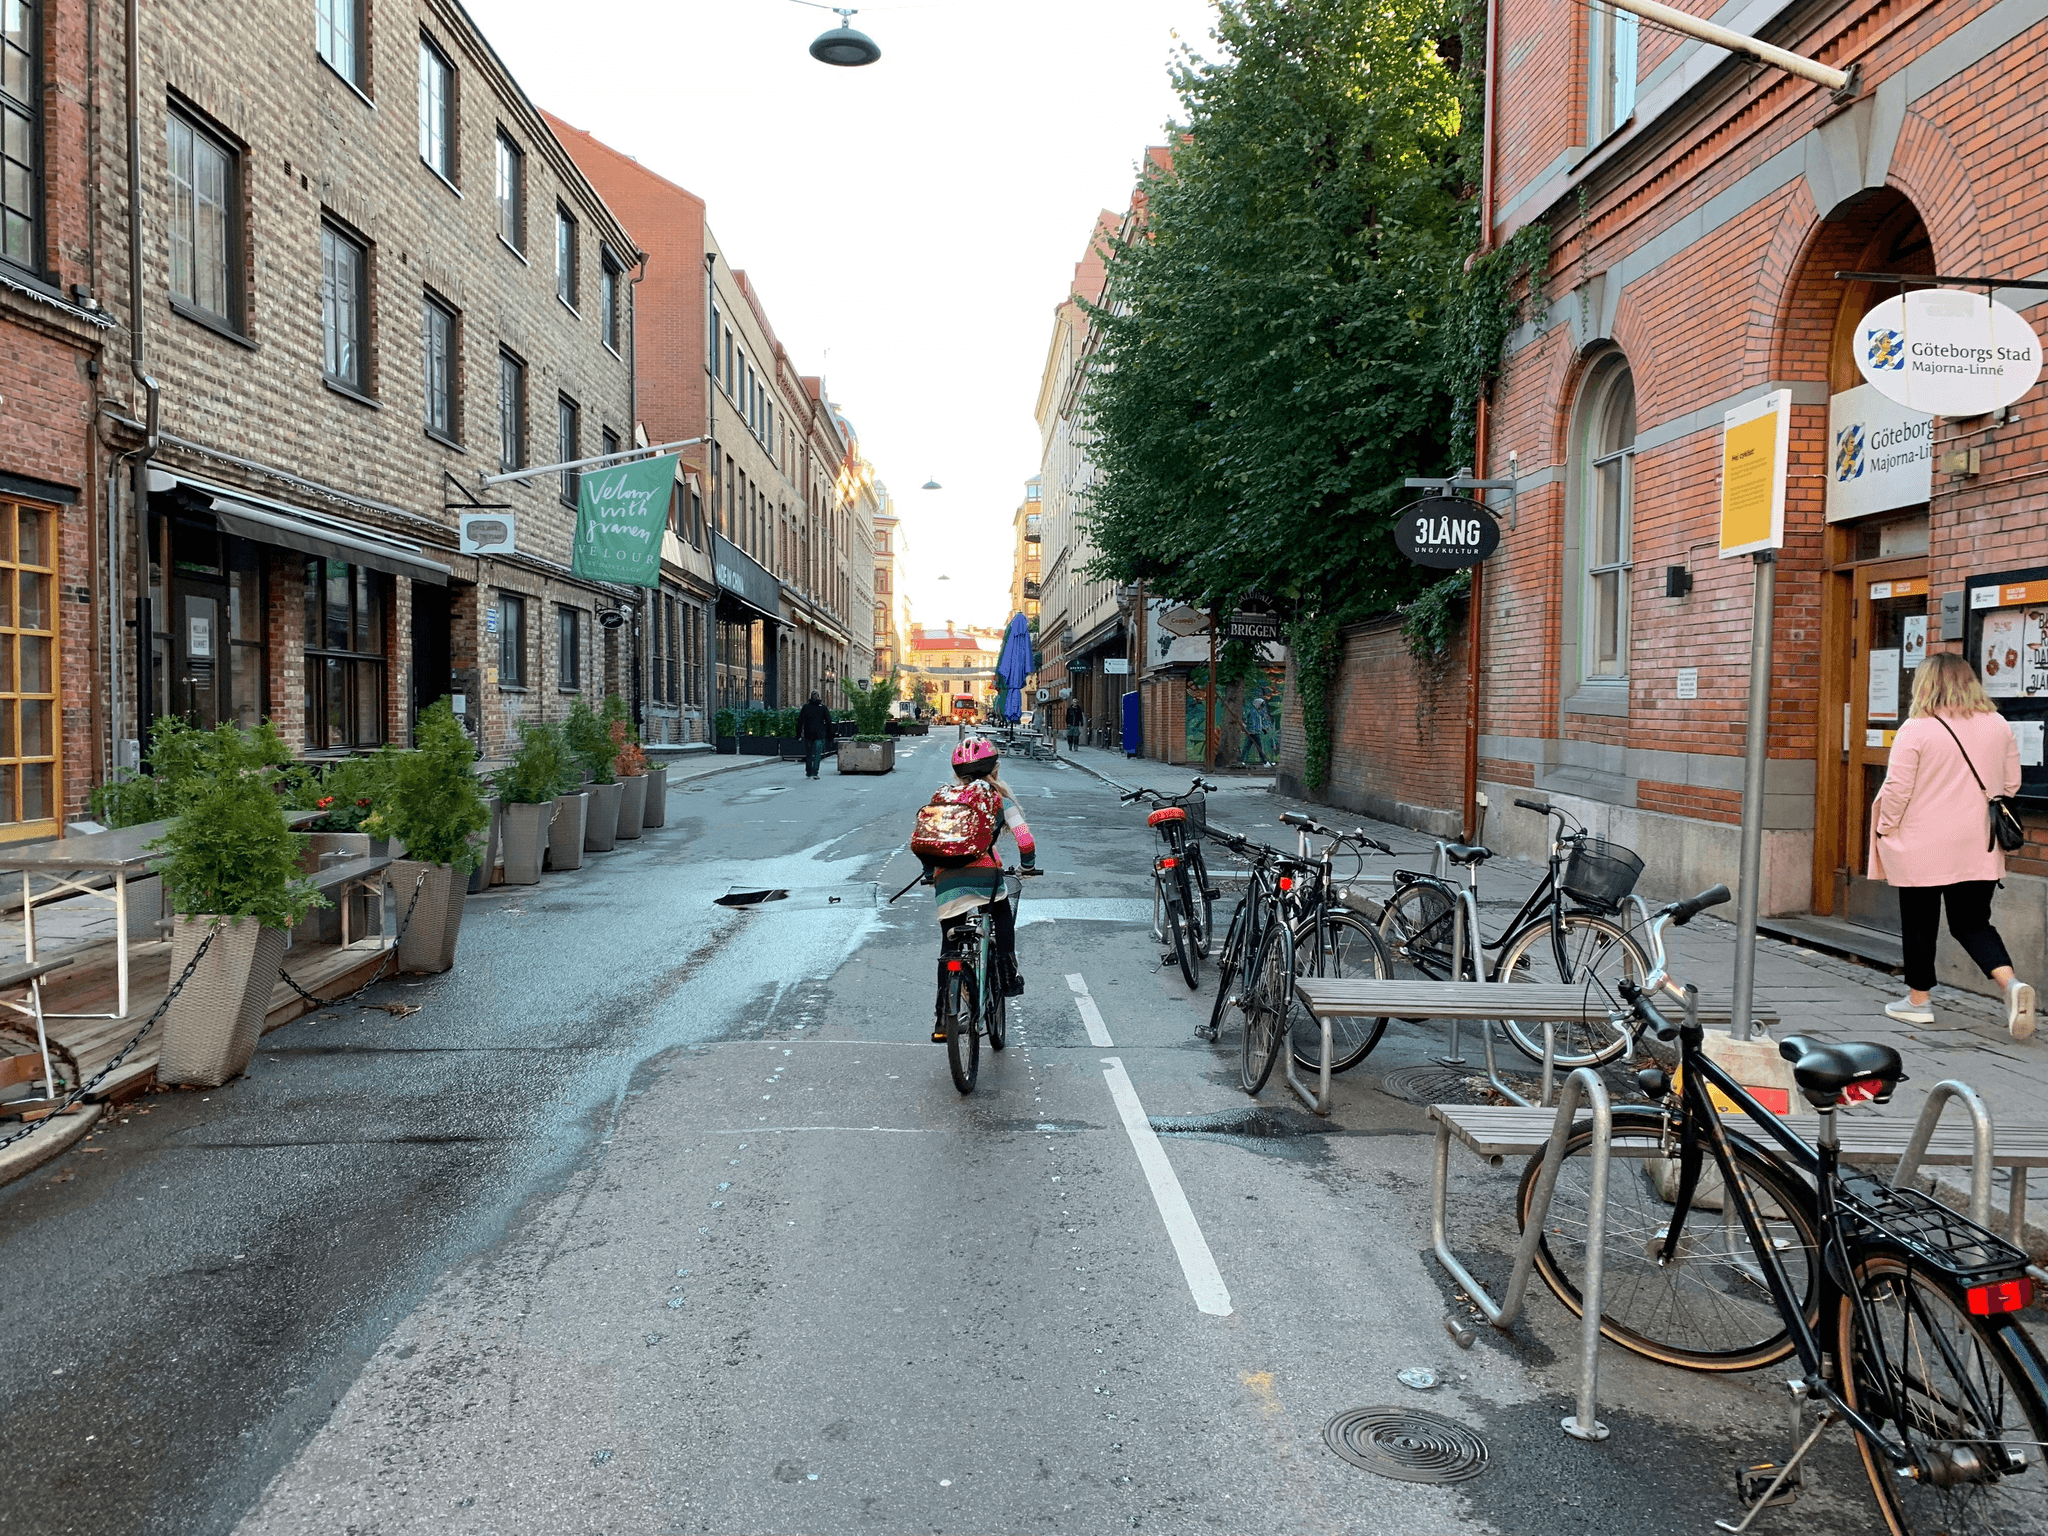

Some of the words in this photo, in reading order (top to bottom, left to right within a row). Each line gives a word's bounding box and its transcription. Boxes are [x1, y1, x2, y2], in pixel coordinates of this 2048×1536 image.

[1911, 342, 1993, 363] Göteborgs
[1997, 347, 2031, 361] Stad
[1912, 361, 2004, 376] Majorna-Linné
[588, 472, 661, 505] Velour
[601, 498, 647, 518] with
[1415, 516, 1480, 546] 3LÅNG
[578, 544, 654, 564] VELOUR
[1414, 547, 1480, 555] UNG/KULTUR
[1230, 623, 1277, 638] BRIGGEN
